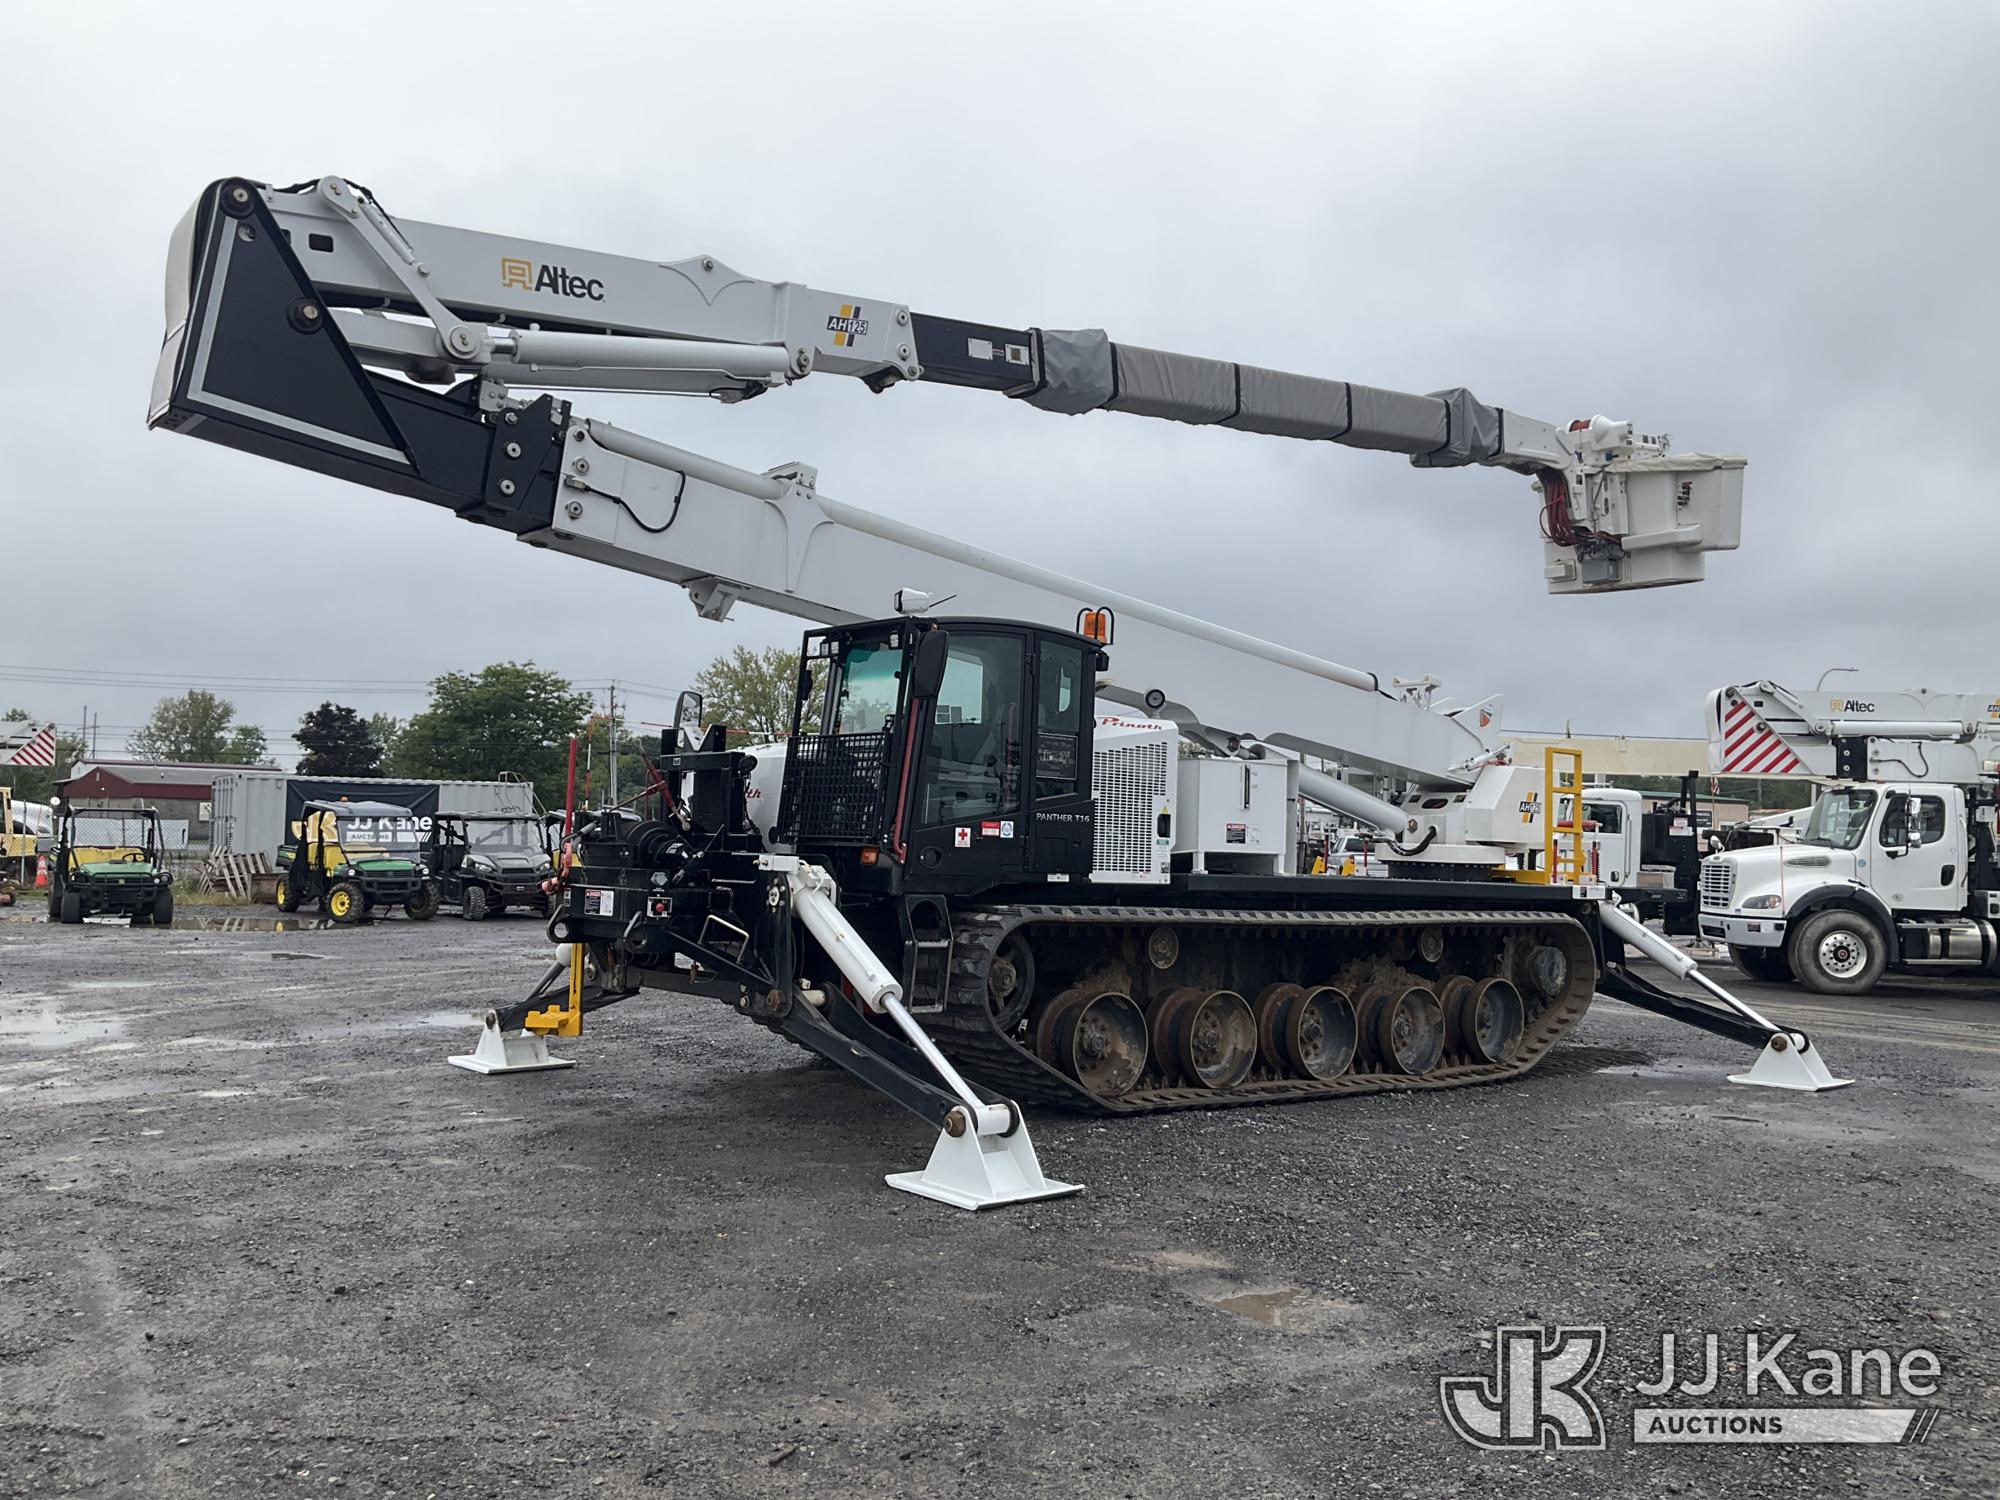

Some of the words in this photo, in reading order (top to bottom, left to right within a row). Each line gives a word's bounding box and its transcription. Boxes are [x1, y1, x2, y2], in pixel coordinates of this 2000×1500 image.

[534, 264, 605, 302] Altec
[827, 316, 868, 335] AH125
[1844, 700, 1875, 713] Altec
[1102, 717, 1162, 730] Prinoth
[347, 816, 373, 830] JJ
[379, 816, 433, 830] Kane
[1036, 812, 1073, 822] PANTHER
[1075, 814, 1090, 823] T16
